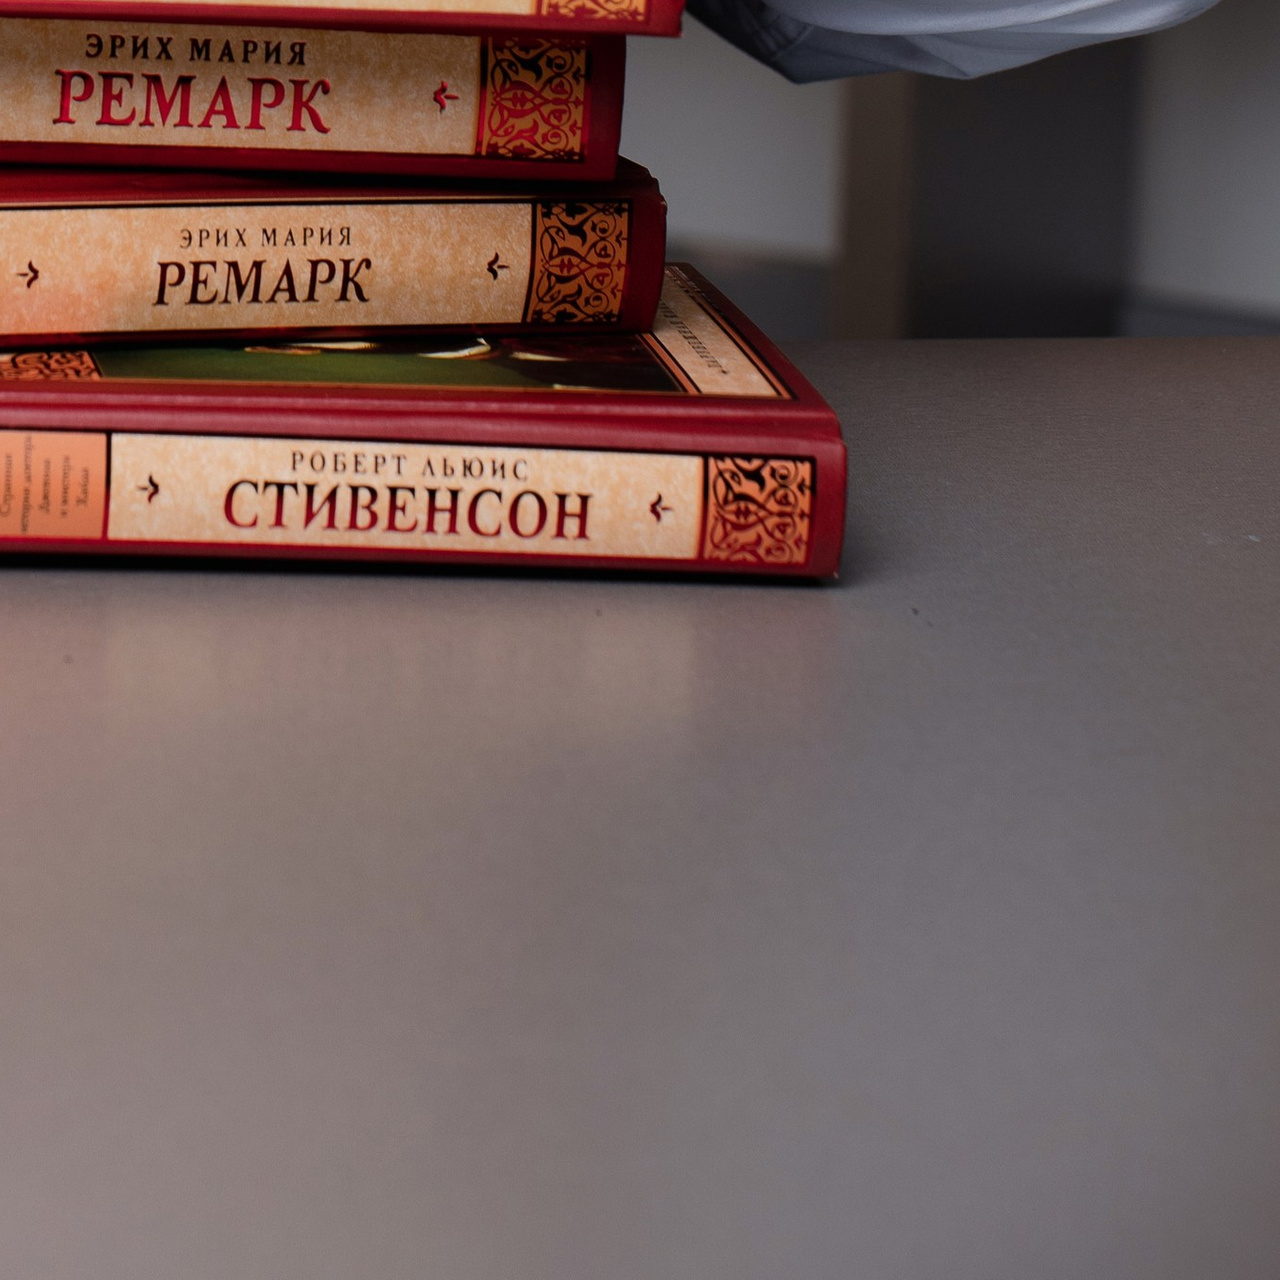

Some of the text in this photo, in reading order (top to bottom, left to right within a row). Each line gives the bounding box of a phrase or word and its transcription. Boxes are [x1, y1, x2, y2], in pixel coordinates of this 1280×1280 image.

[85, 33, 307, 66] ЭРИХ МАРИЯ
[52, 68, 332, 134] РЕМАРК
[179, 225, 352, 249] ЭРИХ МАРИЯ
[152, 256, 373, 307] РЕМАРК
[290, 449, 530, 483] РОБЕРТ ЛЬЮИС
[223, 477, 594, 541] СТИВЕНСОН
